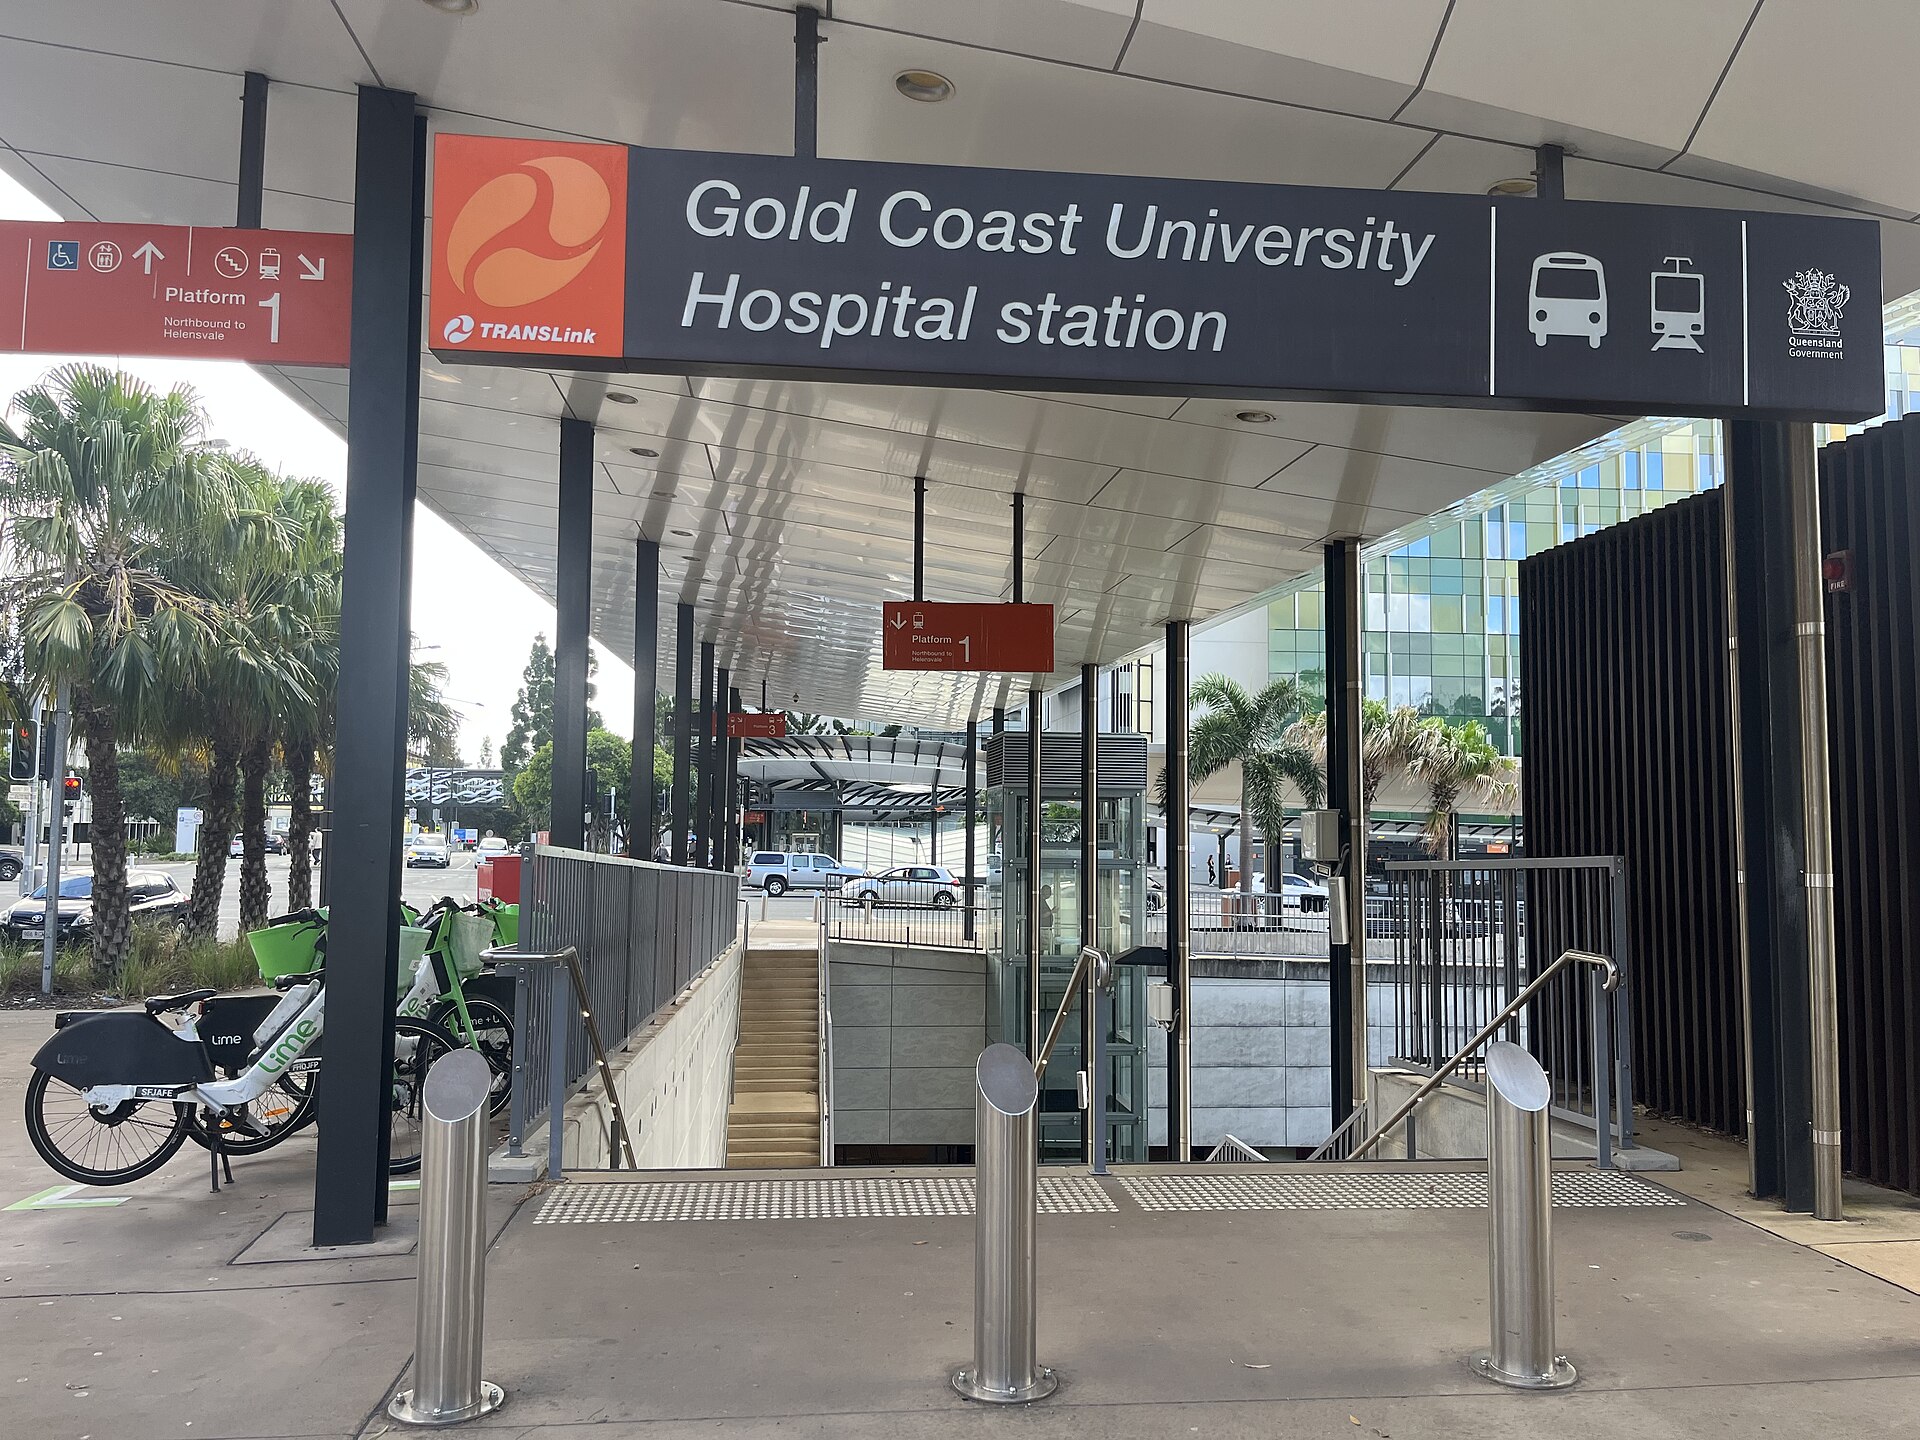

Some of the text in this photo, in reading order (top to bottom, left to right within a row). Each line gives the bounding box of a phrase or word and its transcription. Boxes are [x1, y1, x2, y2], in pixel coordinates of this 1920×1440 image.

[685, 178, 1436, 287] Gold Coast University
[165, 287, 281, 344] Platform 1
[681, 271, 1228, 353] Hospital station
[164, 317, 246, 330] Northbound to
[164, 328, 225, 341] Helensvale
[480, 323, 597, 344] TRANSLink
[1788, 337, 1843, 349] Queensland
[1788, 348, 1844, 360] Government
[1830, 580, 1846, 591] FIRE
[912, 635, 970, 663] Platform 1
[768, 725, 776, 735] 3
[212, 1035, 242, 1045] Lime
[258, 1020, 318, 1073] Lime
[57, 1053, 88, 1064] Lime
[141, 1088, 173, 1097] SFJAFE
